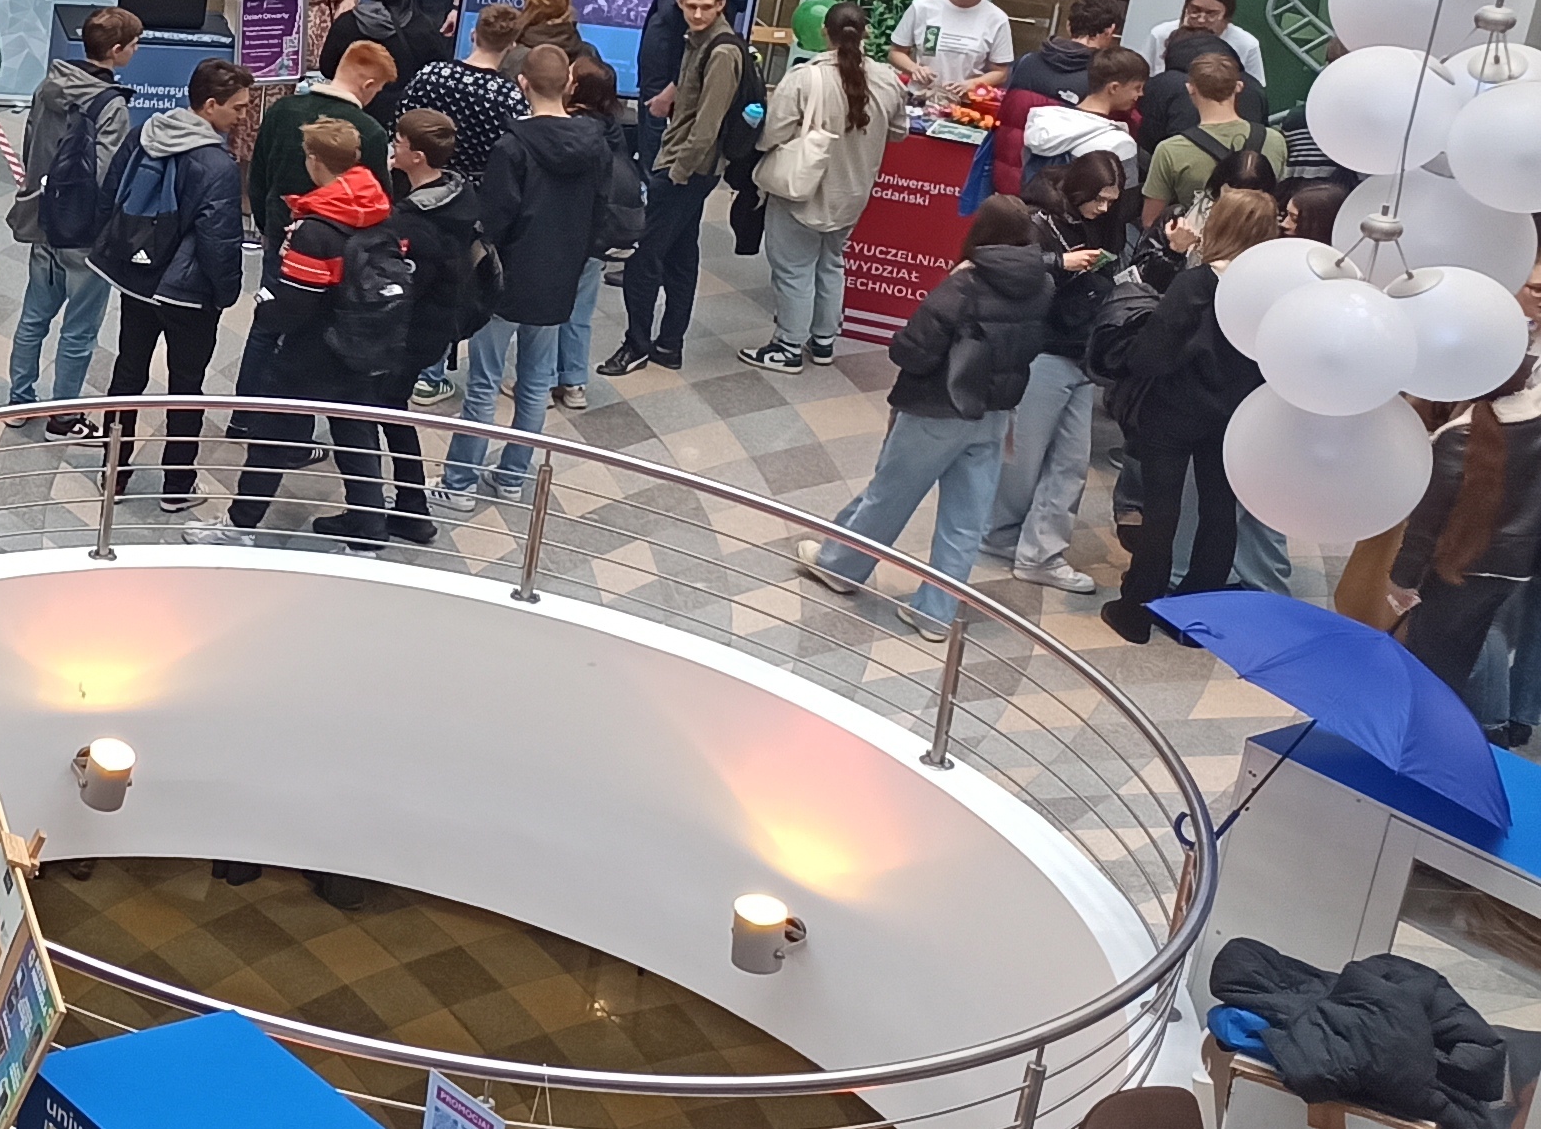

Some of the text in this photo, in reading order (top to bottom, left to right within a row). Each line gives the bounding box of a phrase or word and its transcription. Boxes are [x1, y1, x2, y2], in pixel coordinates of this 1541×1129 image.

[872, 187, 930, 206] Gdański
[875, 173, 961, 197] Uniwersytet
[842, 240, 955, 270] ZYUCZELNIAN
[844, 258, 920, 282] WYDZIAŁ
[845, 276, 928, 301] ECHNOLO
